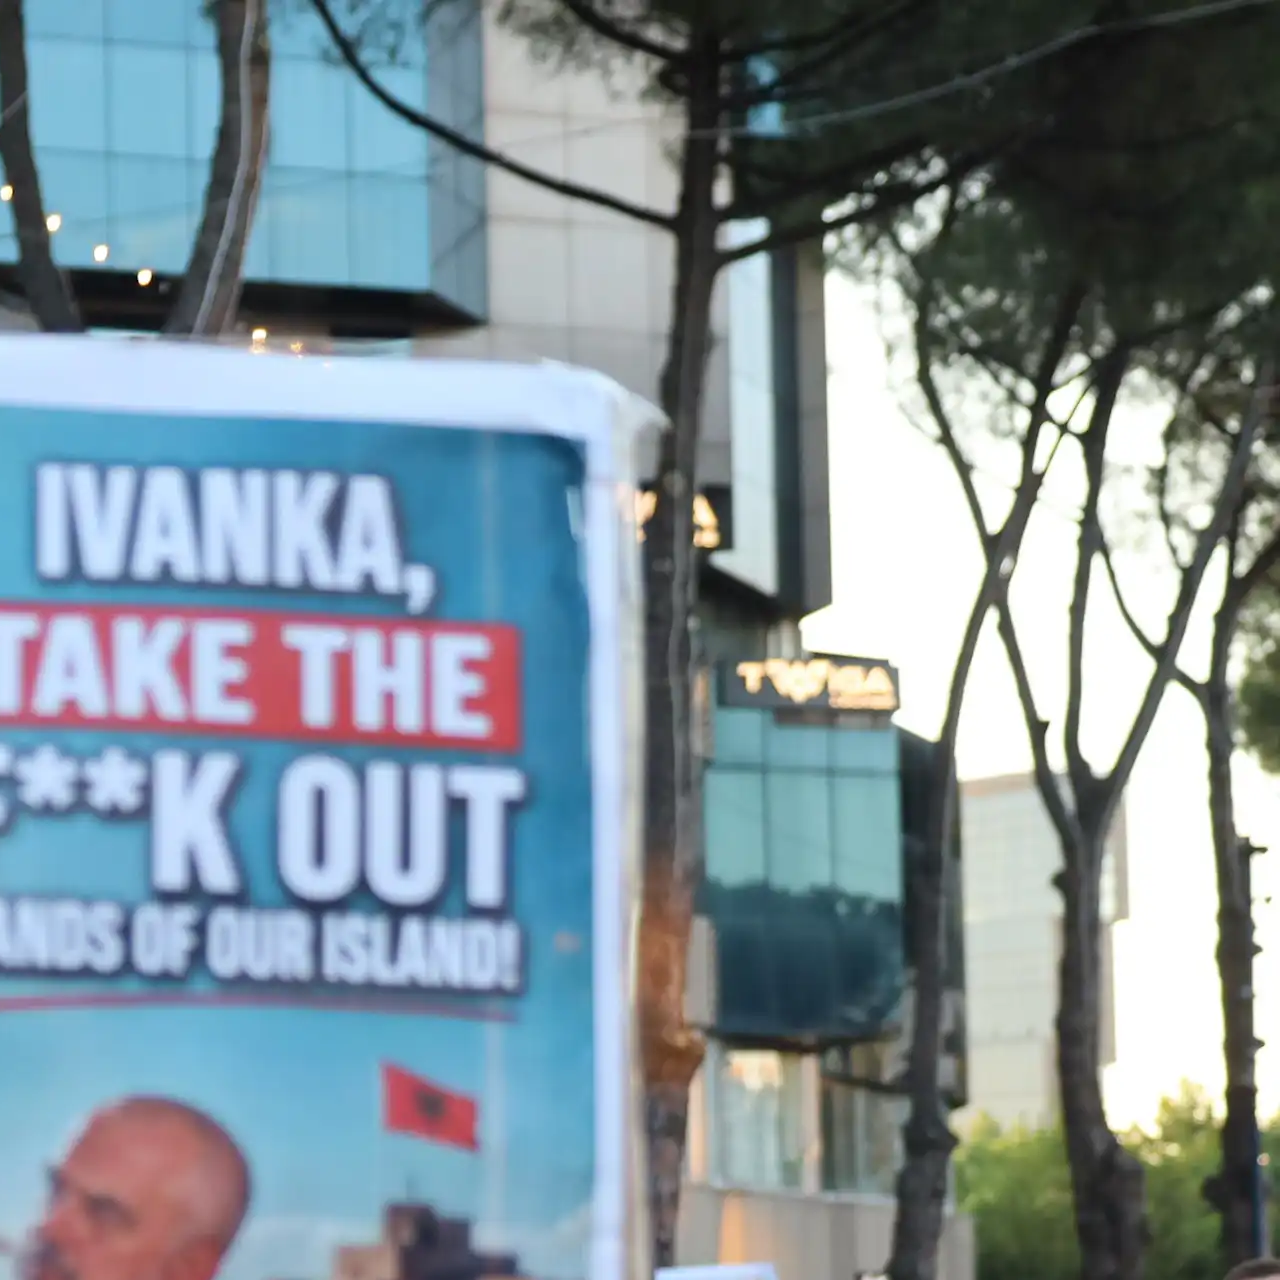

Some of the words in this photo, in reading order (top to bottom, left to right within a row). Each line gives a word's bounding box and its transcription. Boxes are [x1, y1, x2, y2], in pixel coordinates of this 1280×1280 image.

[36, 462, 437, 614] IVANKA,
[281, 622, 494, 738] THE
[277, 755, 525, 907] OUT
[131, 903, 198, 977] OF
[206, 907, 315, 982] OUR
[322, 912, 521, 991] ISLAND!
